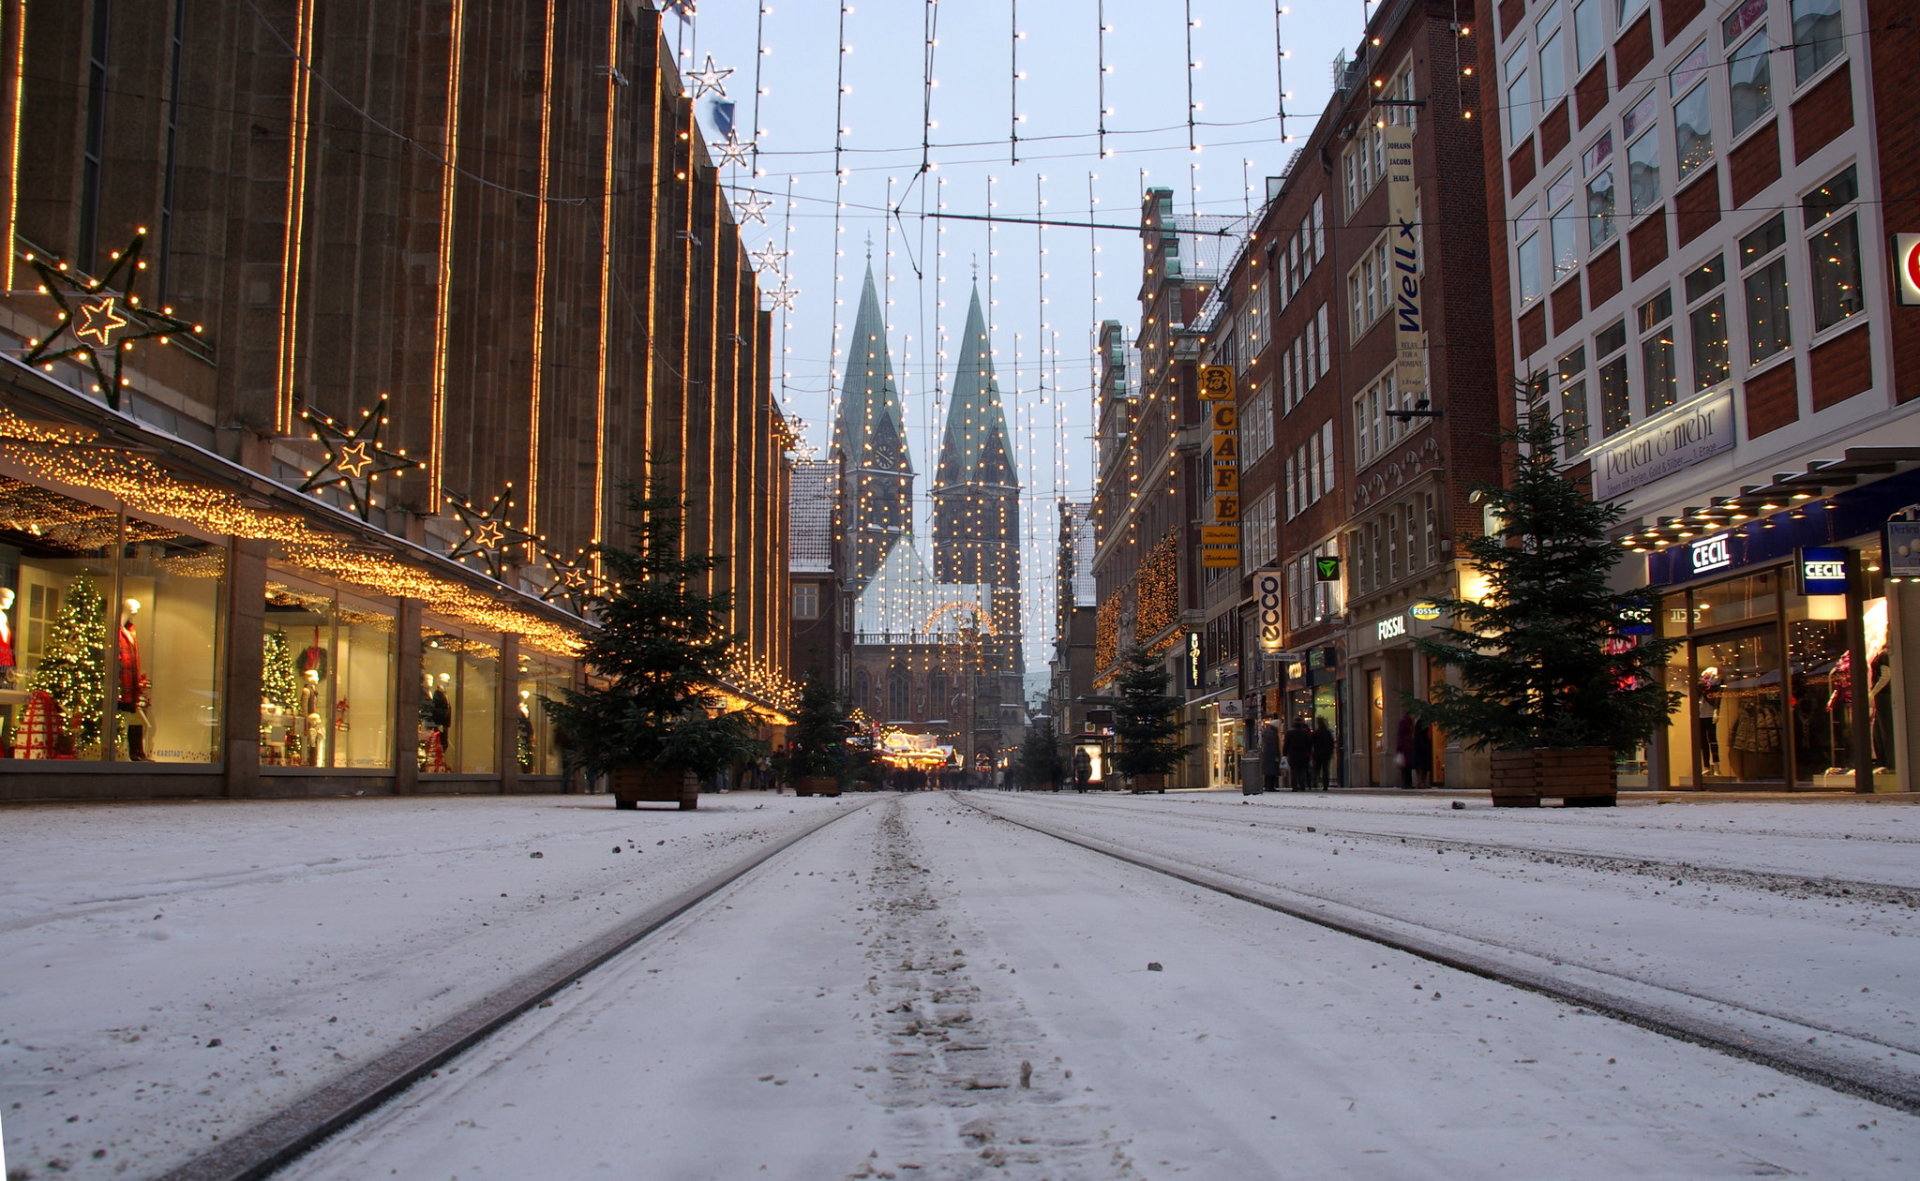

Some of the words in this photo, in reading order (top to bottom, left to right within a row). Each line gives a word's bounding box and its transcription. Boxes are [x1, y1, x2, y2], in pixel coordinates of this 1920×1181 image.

[1215, 407, 1237, 518] CAFÉ
[1605, 439, 1652, 480] Perlen
[1673, 405, 1715, 450] mehr
[1692, 539, 1730, 568] CECIL
[1805, 564, 1845, 576] CECIL
[1261, 577, 1280, 641] ecco
[1379, 615, 1405, 640] FOSSIL
